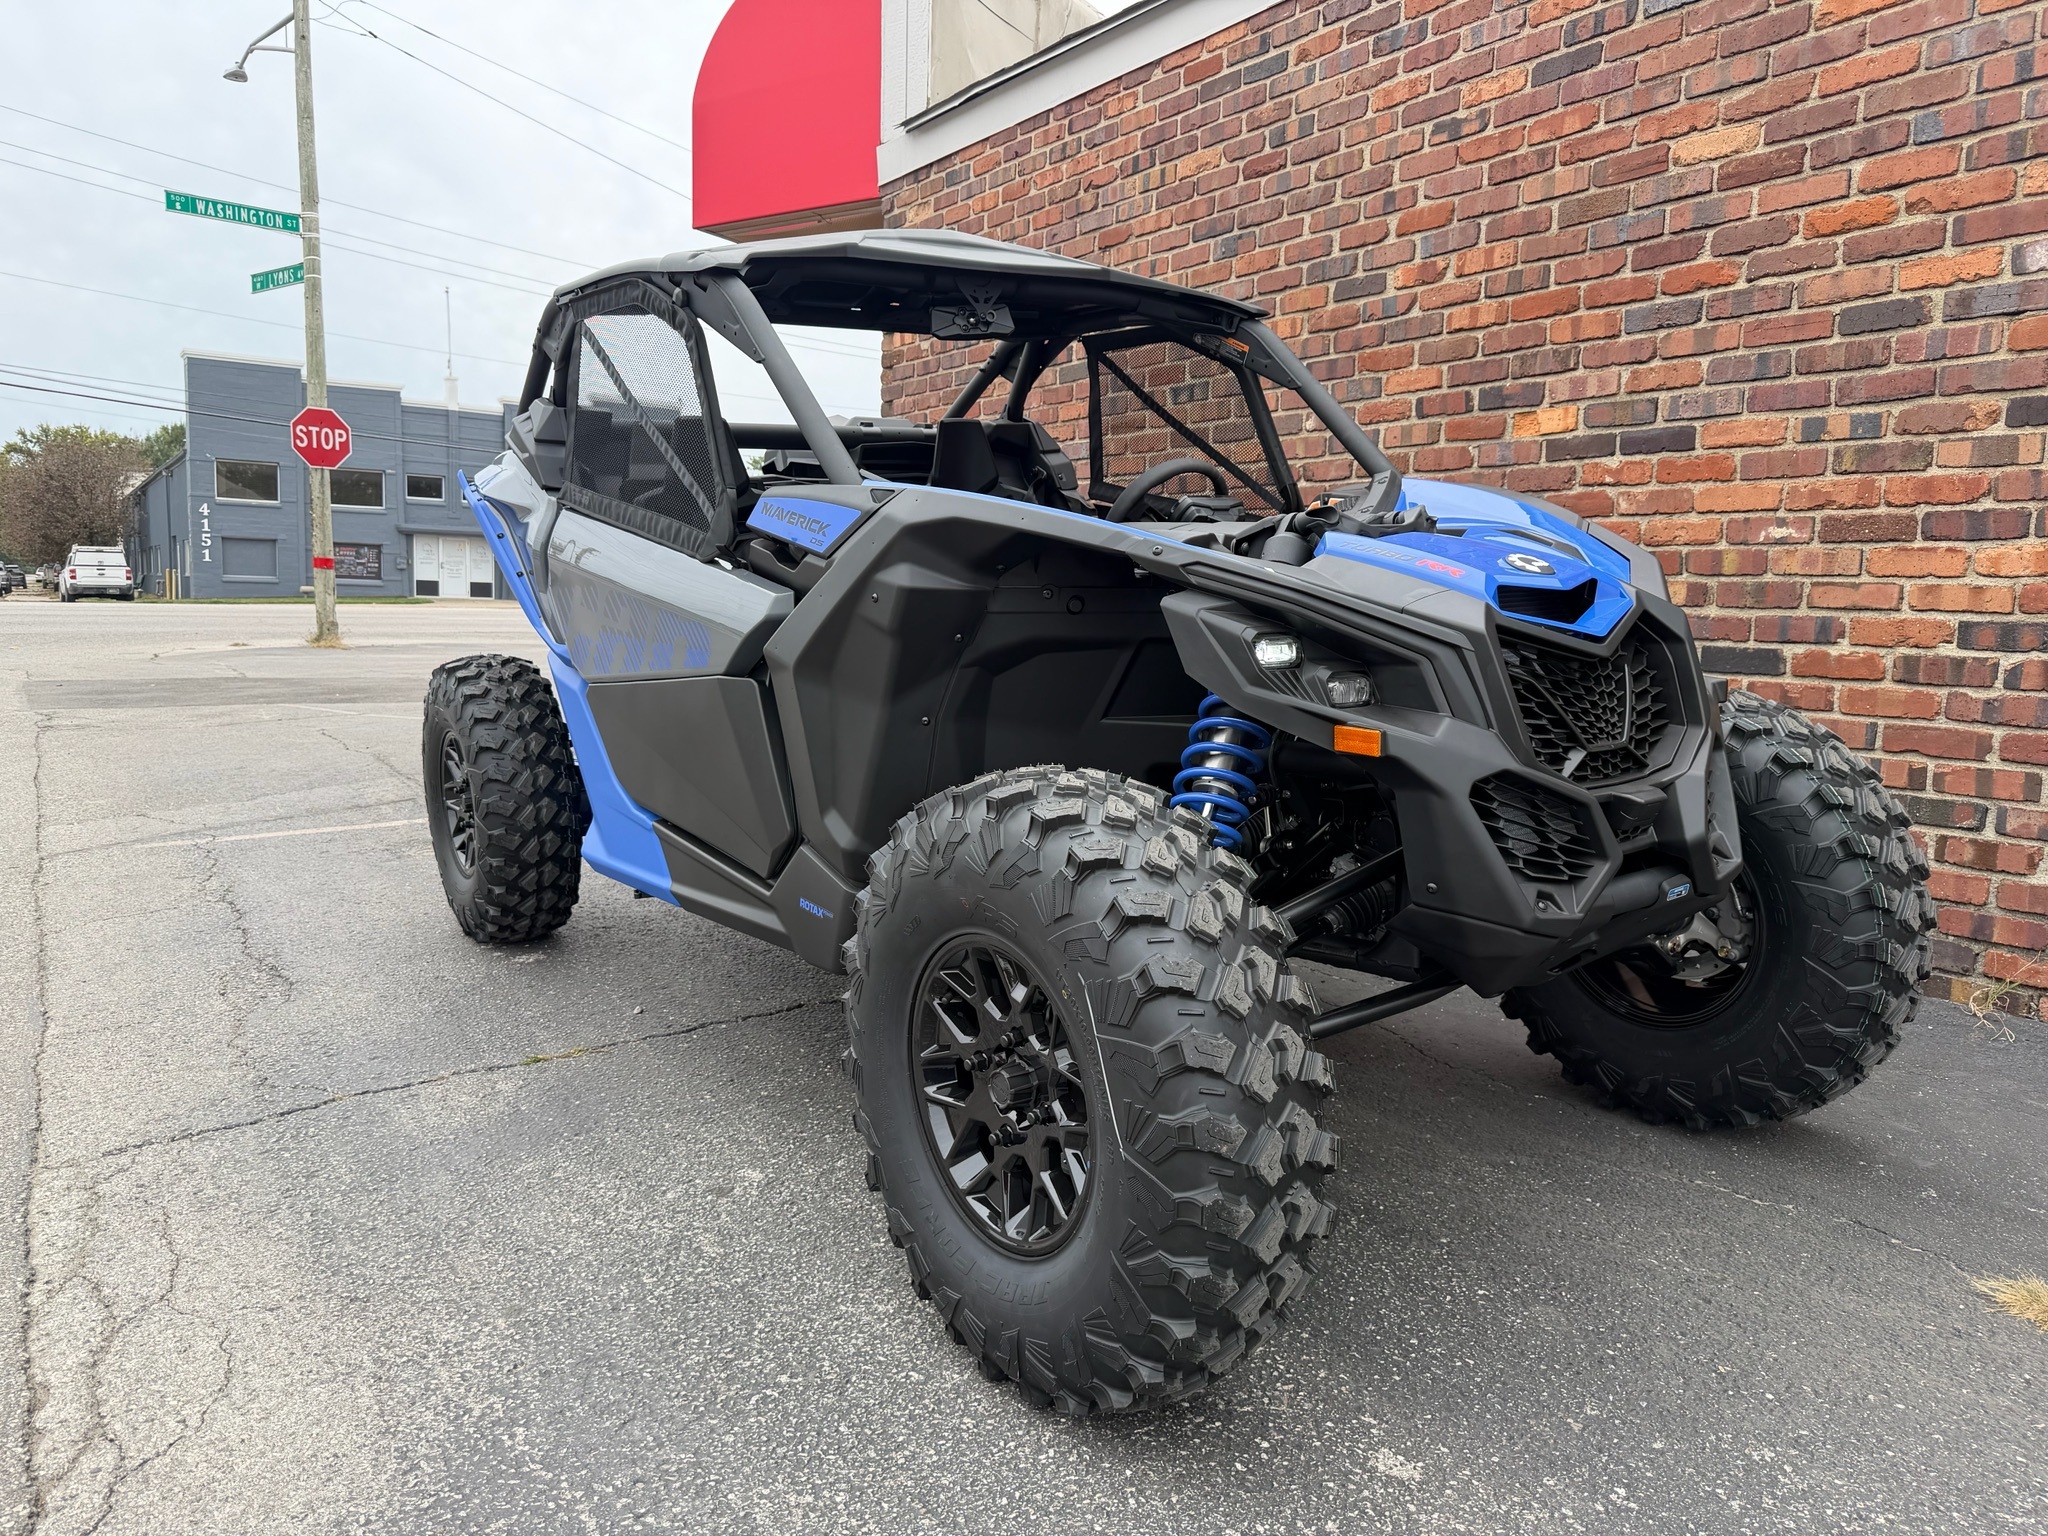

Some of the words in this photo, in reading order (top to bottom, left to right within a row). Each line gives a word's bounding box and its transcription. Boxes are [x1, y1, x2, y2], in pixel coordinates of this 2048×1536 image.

[170, 194, 186, 203] 500
[175, 201, 182, 210] S
[195, 199, 283, 229] WASHINGTON
[286, 219, 297, 228] ST
[268, 268, 295, 289] LYONS
[295, 424, 348, 451] STOP
[761, 501, 831, 537] MAVERICK
[198, 502, 213, 563] 4151
[809, 536, 825, 547] DS
[1339, 541, 1417, 562] TURBO
[799, 897, 823, 918] ROTAX
